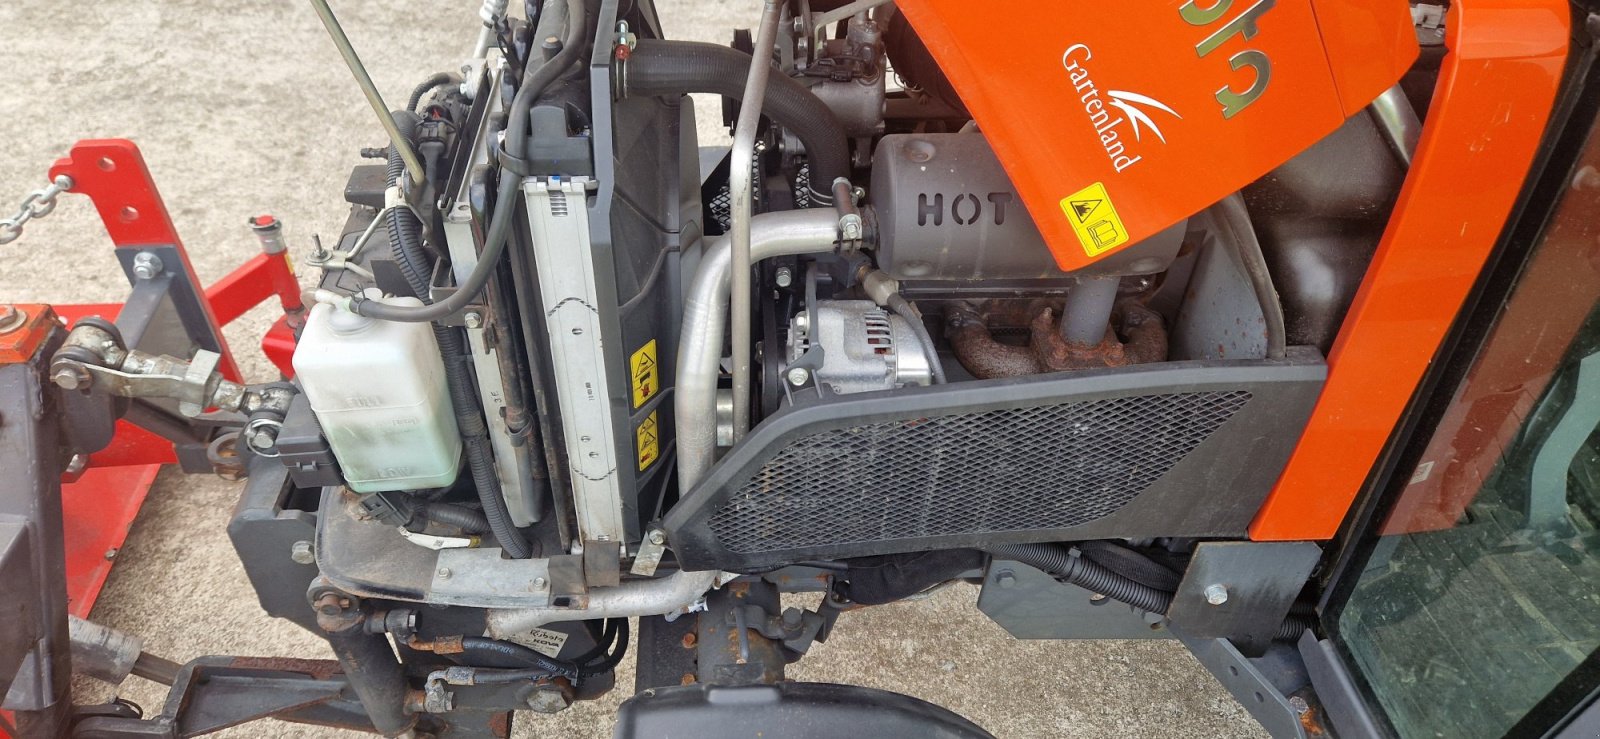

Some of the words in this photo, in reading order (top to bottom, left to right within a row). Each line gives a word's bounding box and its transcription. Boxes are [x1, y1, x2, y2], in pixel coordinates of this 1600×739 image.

[1062, 43, 1142, 173] Gartenland
[918, 192, 1013, 226] HOT
[530, 629, 564, 642] Kubota
[533, 638, 559, 648] KOVA
